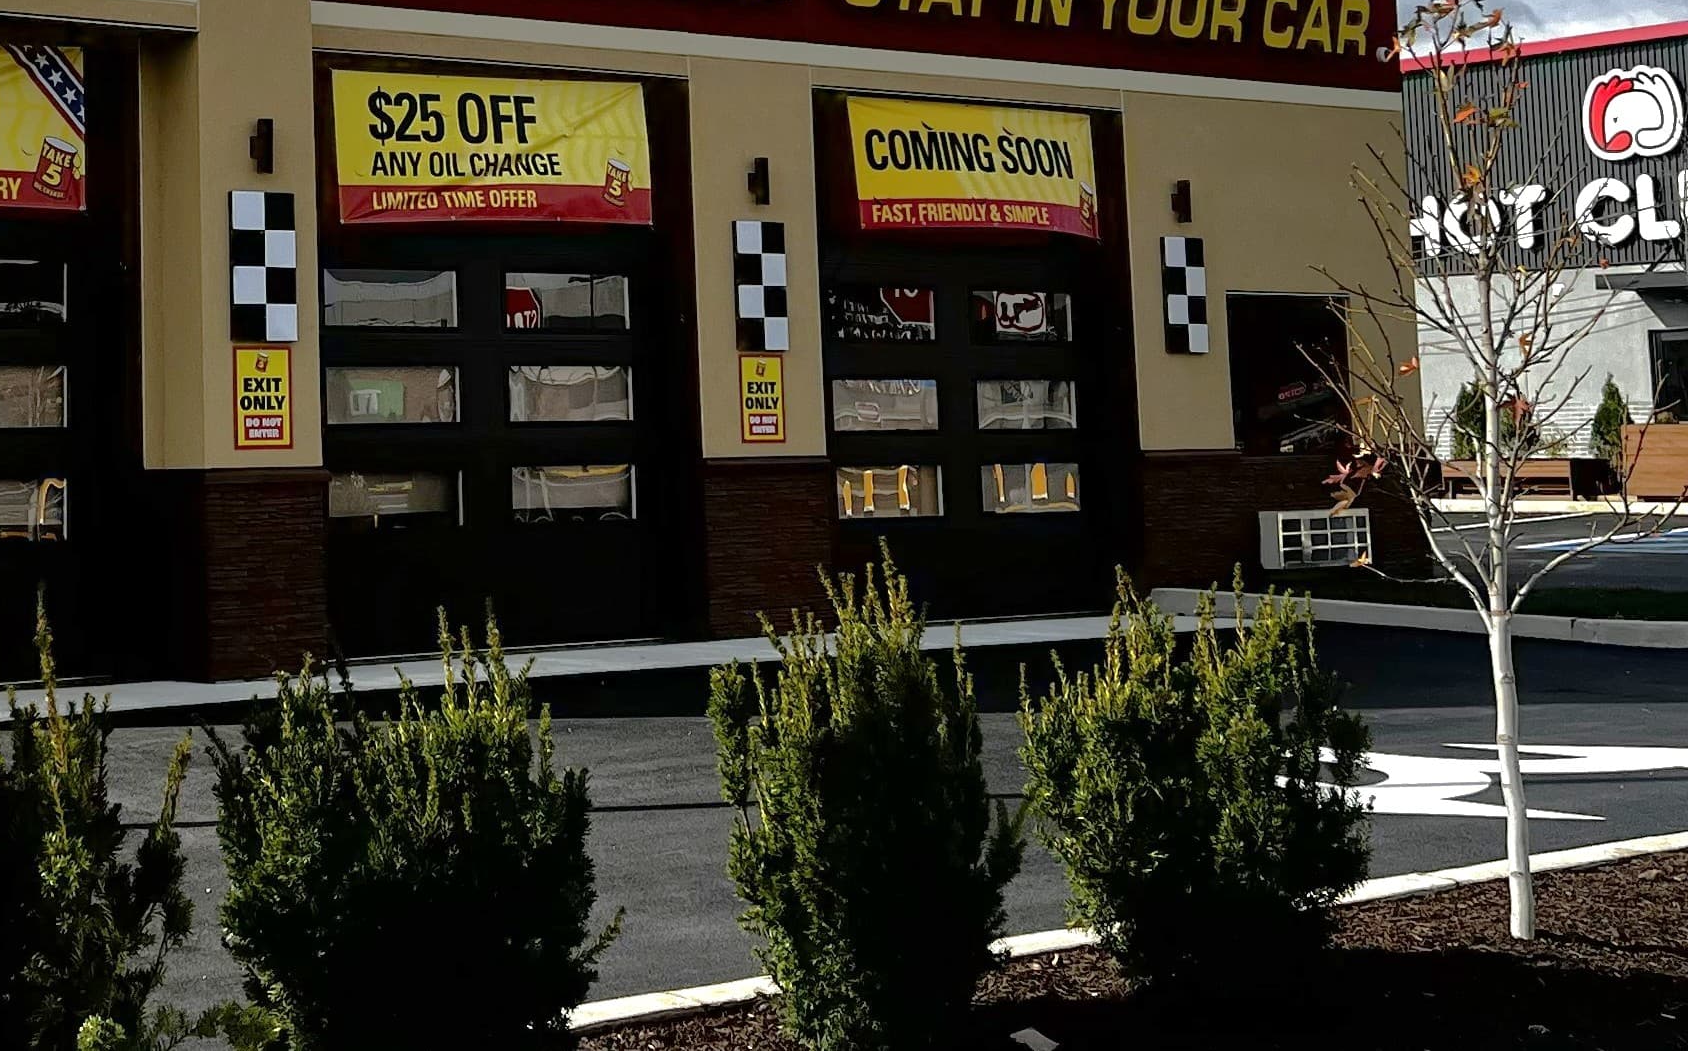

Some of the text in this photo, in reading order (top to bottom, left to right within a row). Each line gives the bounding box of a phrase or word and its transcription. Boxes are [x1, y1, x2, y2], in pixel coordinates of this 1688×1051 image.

[367, 86, 537, 146] $25 OFF
[42, 142, 72, 168] TAKE
[371, 152, 562, 177] ANY OIL CHANGE
[864, 128, 1074, 180] COMING SOON
[41, 162, 62, 186] 5
[609, 179, 622, 197] 5
[372, 190, 538, 210] LIMITED TIME OFFER
[1575, 169, 1688, 248] CL
[918, 203, 987, 225] FRIENDLY
[989, 207, 1000, 223] &
[1004, 206, 1050, 225] SIMPLE
[243, 377, 282, 393] EXIT
[747, 381, 776, 394] EXIT
[240, 395, 285, 411] ONLY
[745, 396, 779, 409] ONLY
